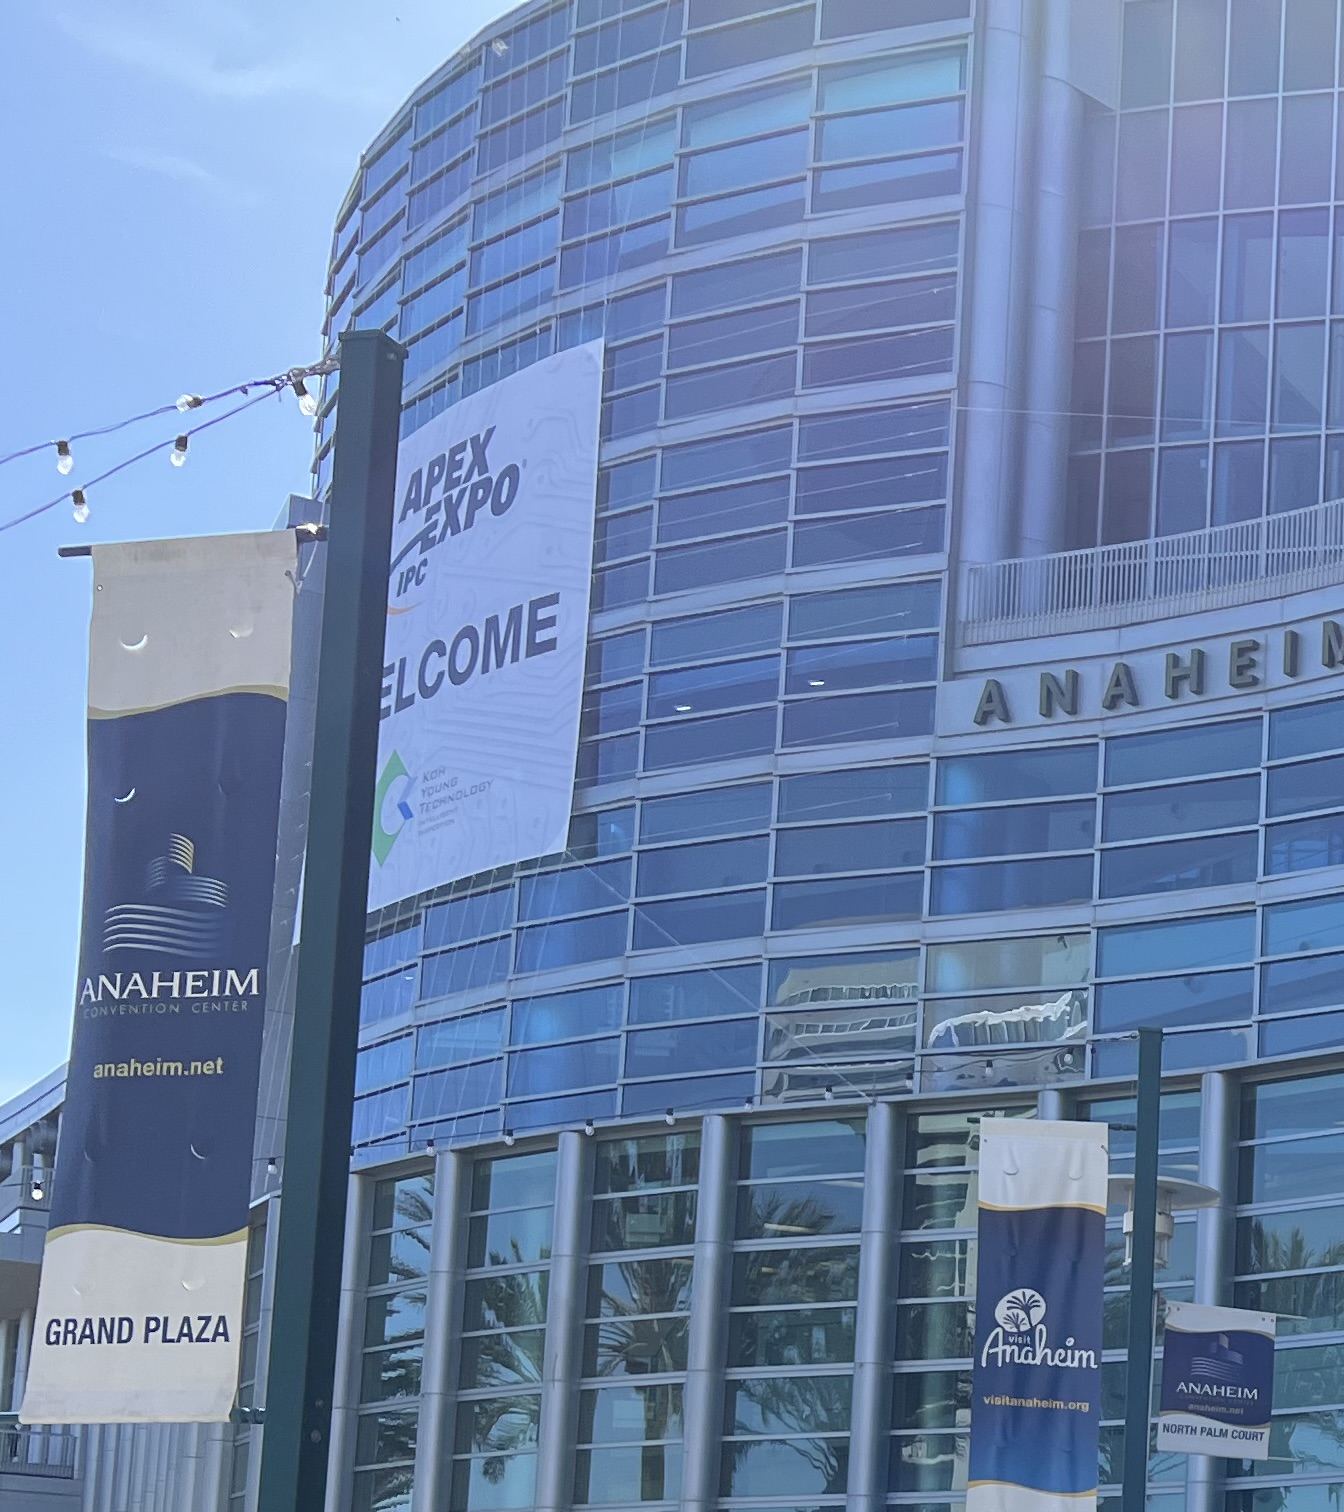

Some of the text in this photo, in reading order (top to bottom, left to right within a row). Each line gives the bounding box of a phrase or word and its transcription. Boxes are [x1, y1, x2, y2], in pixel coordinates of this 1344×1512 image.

[398, 424, 497, 525] APEX
[419, 462, 520, 555] EXPO
[396, 557, 428, 598] IPC
[418, 779, 495, 815] TECHNOLOGY
[421, 776, 459, 799] YOUNG
[79, 967, 261, 1006] ANAHEIM
[83, 1000, 249, 1019] CONVENTION CENTER
[92, 1056, 225, 1079] anaheim.net
[45, 1315, 231, 1346] GRAND PLAZA
[1008, 1334, 1032, 1345] visit
[981, 1323, 1099, 1369] Anaheim
[982, 1394, 1090, 1413] visitanaheim.org
[1175, 1381, 1259, 1401] ANAHEIM
[1162, 1422, 1266, 1442] NORTH PALM COURT
